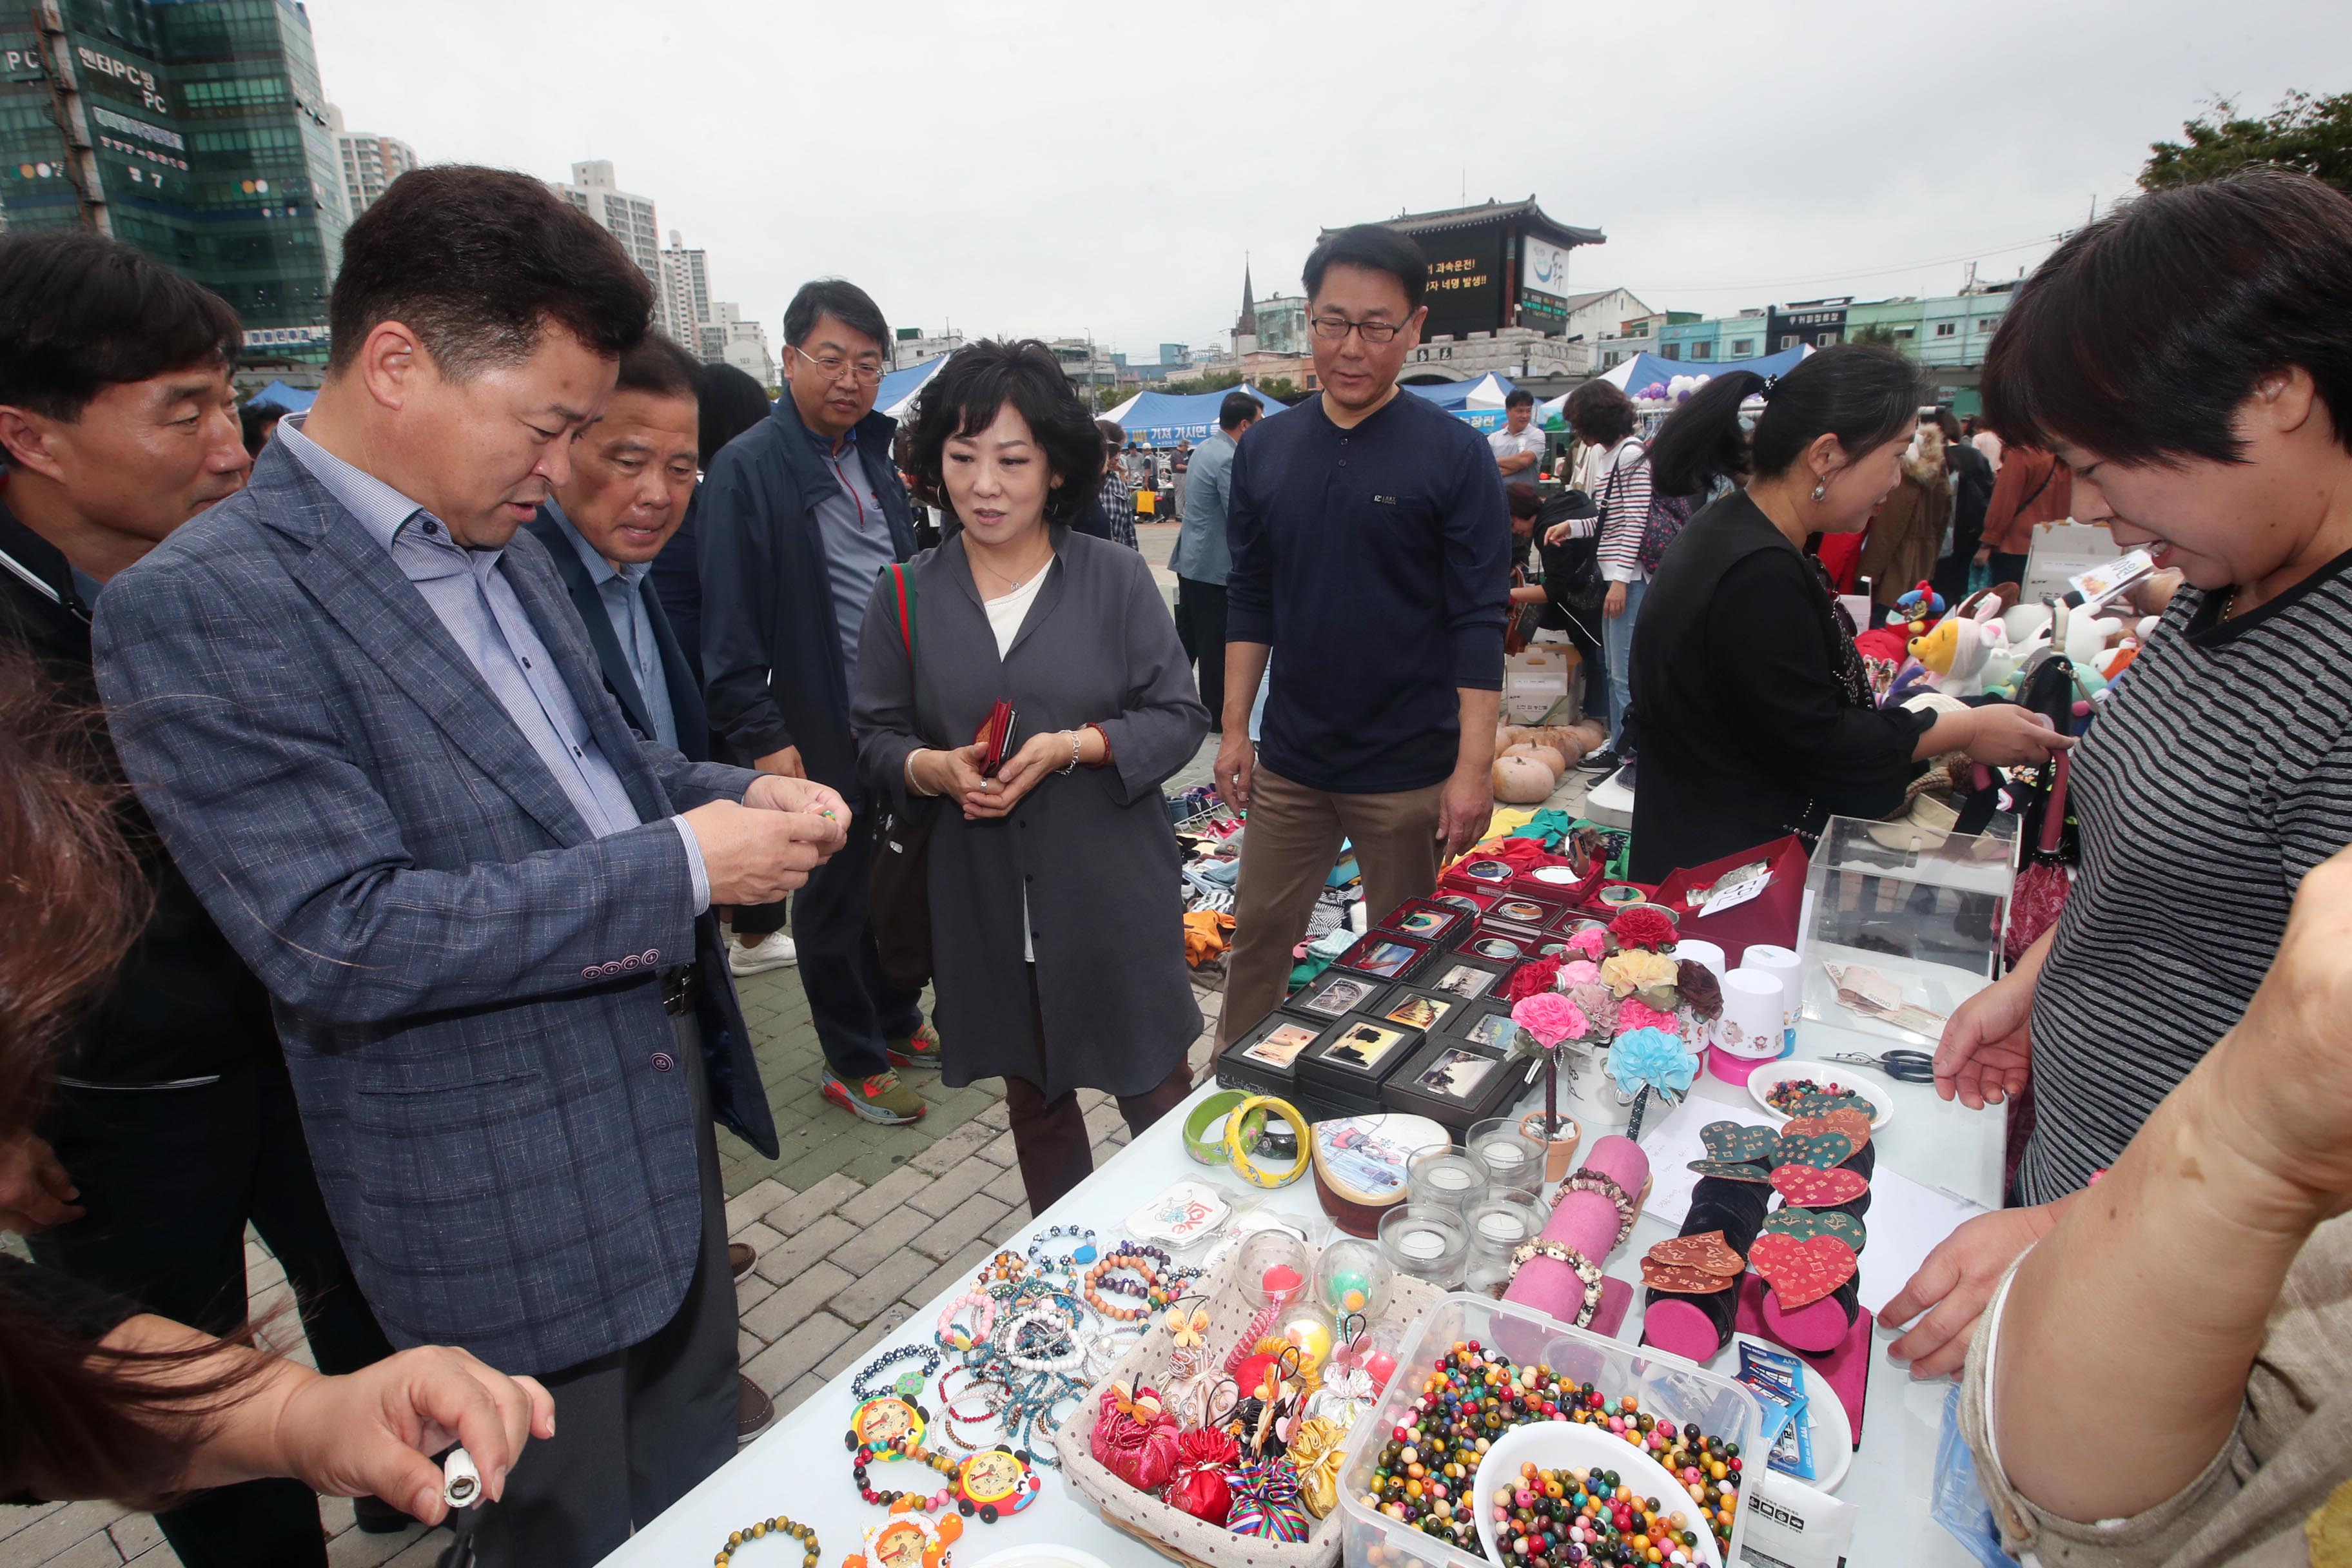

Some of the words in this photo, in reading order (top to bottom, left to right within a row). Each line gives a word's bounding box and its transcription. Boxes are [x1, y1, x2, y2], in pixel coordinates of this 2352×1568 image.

[142, 90, 166, 113] PC
[1436, 259, 1476, 273] 과속운전!
[1442, 278, 1460, 289] 네명
[1463, 275, 1487, 288] 발생!!
[1151, 427, 1171, 439] 가져
[1175, 425, 1207, 438] 가시면
[1867, 993, 1891, 1008] 5000
[1783, 1358, 1798, 1366] AAA
[1790, 1390, 1805, 1400] AAA
